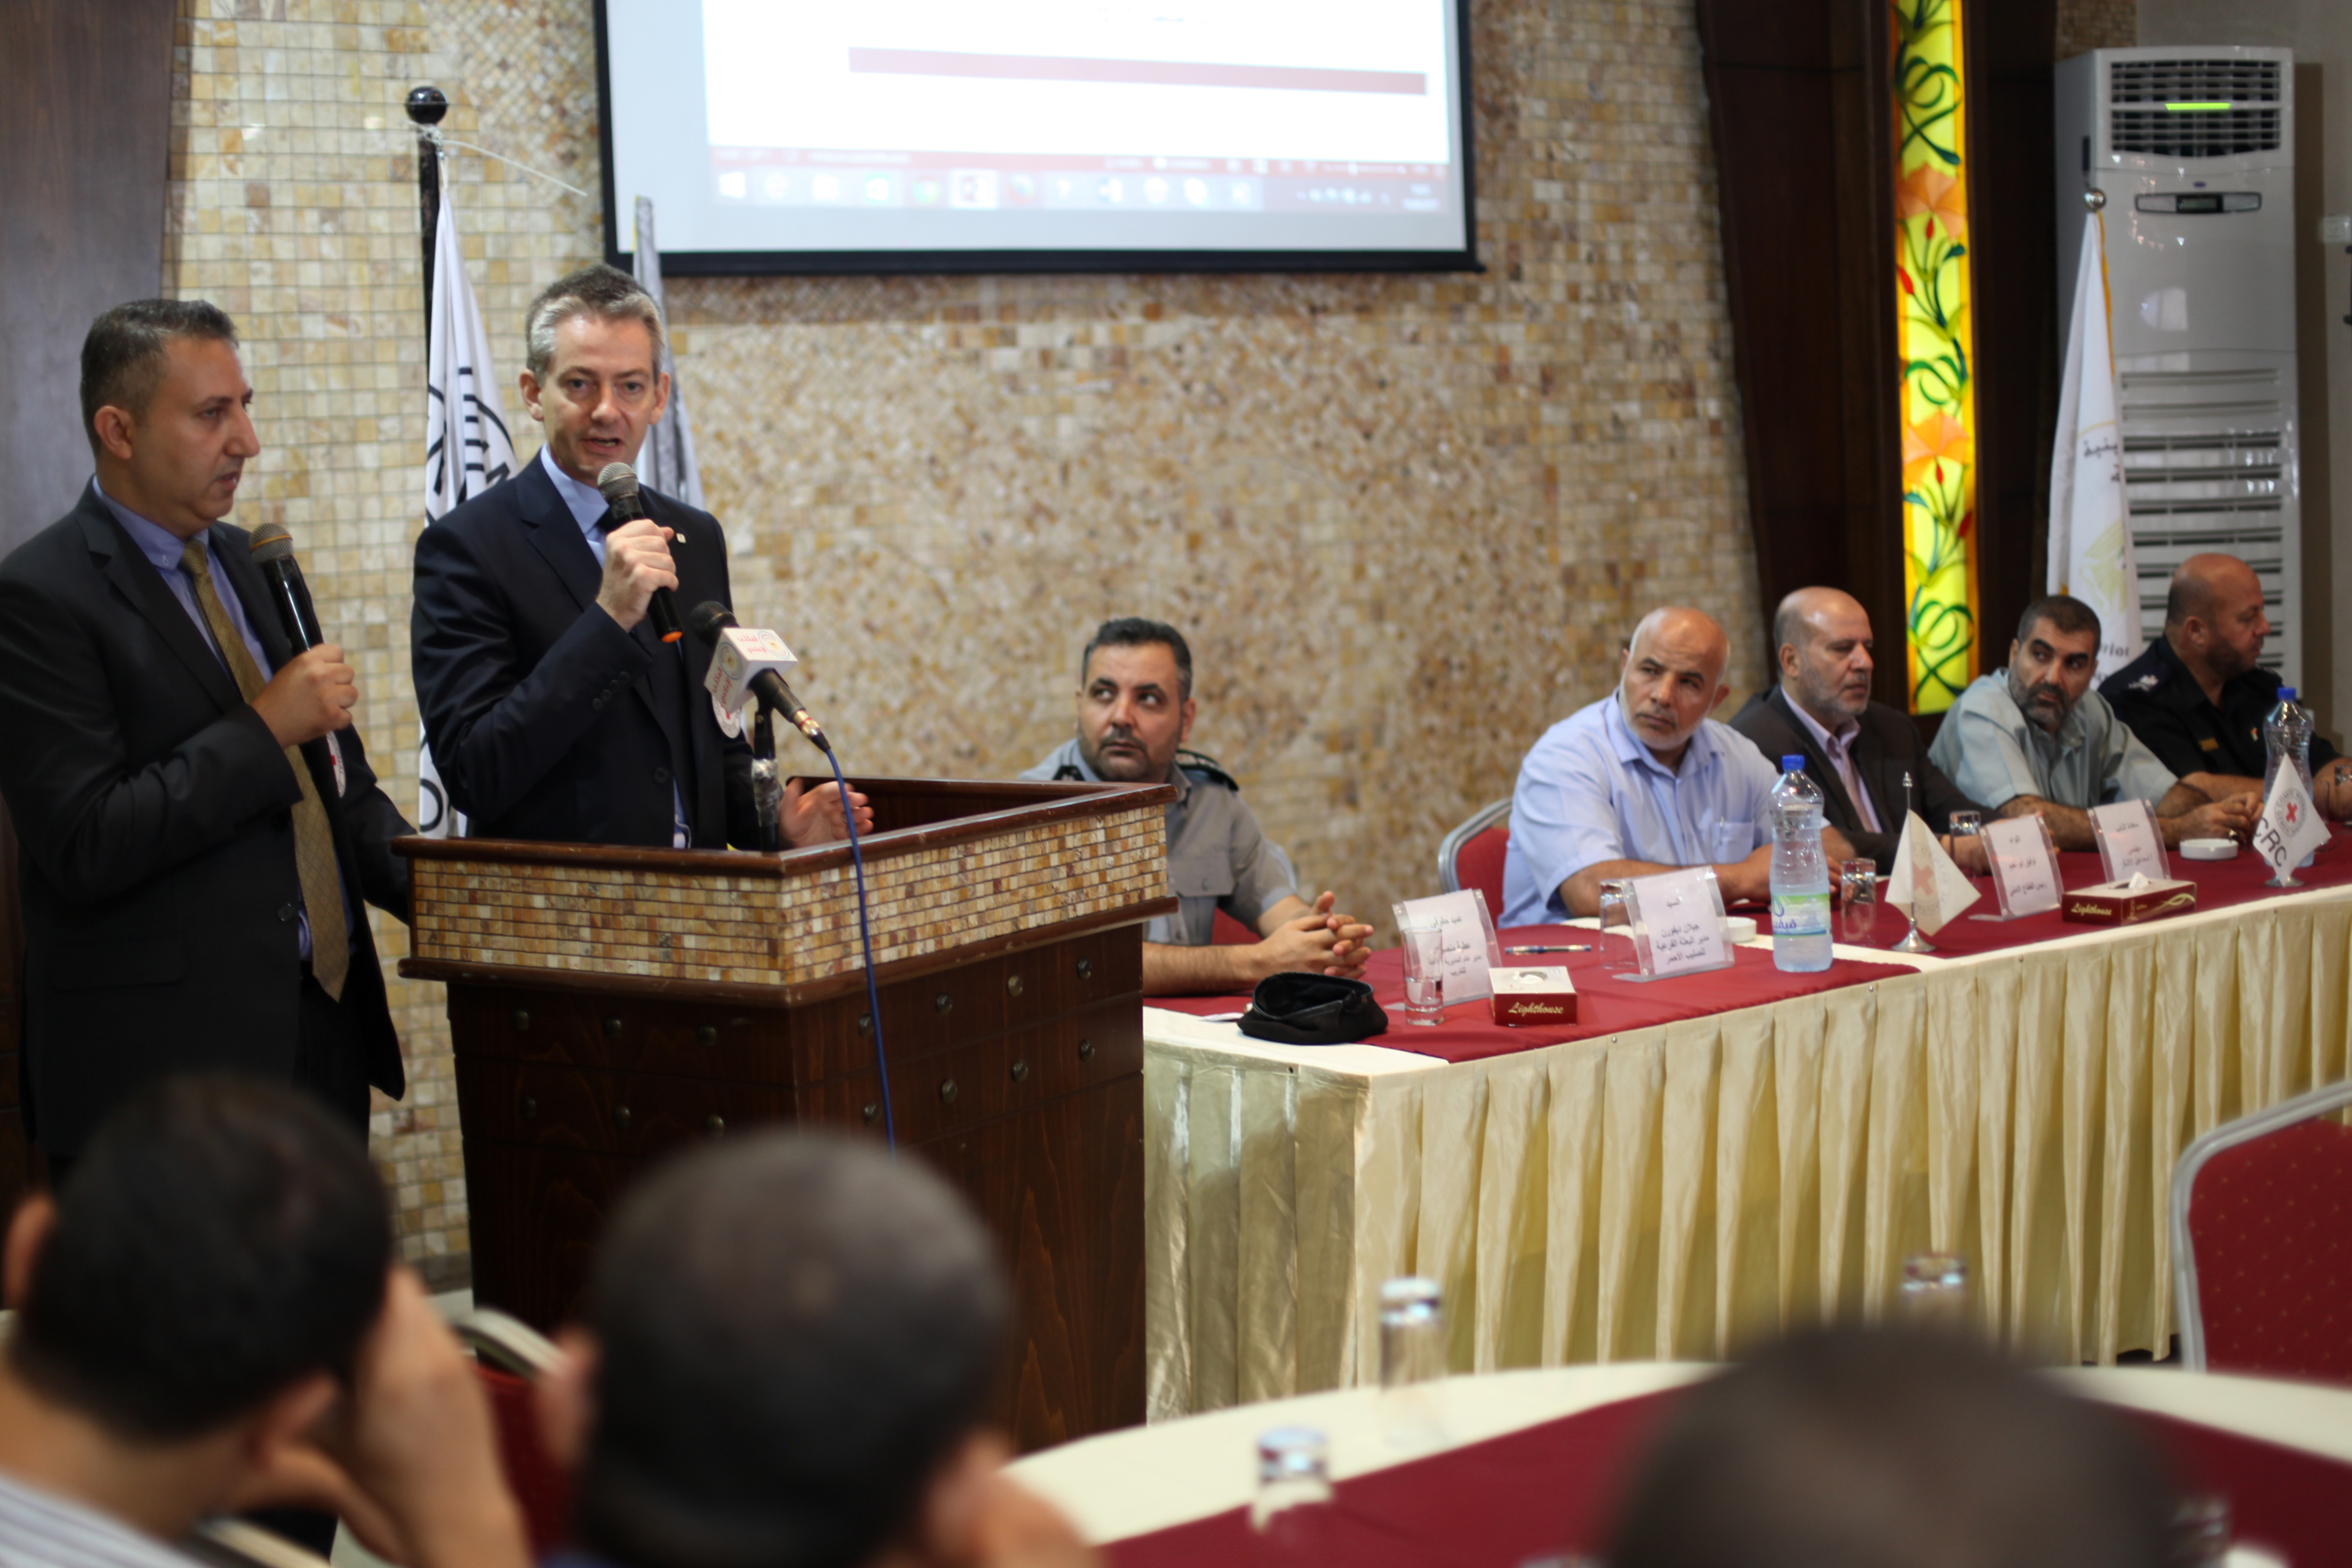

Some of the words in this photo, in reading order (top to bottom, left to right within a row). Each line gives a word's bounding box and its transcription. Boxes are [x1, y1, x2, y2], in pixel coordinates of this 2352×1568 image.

[2254, 817, 2287, 867] CRC
[2071, 903, 2112, 916] Lighthouse
[1508, 1001, 1564, 1017] Lighthouse
